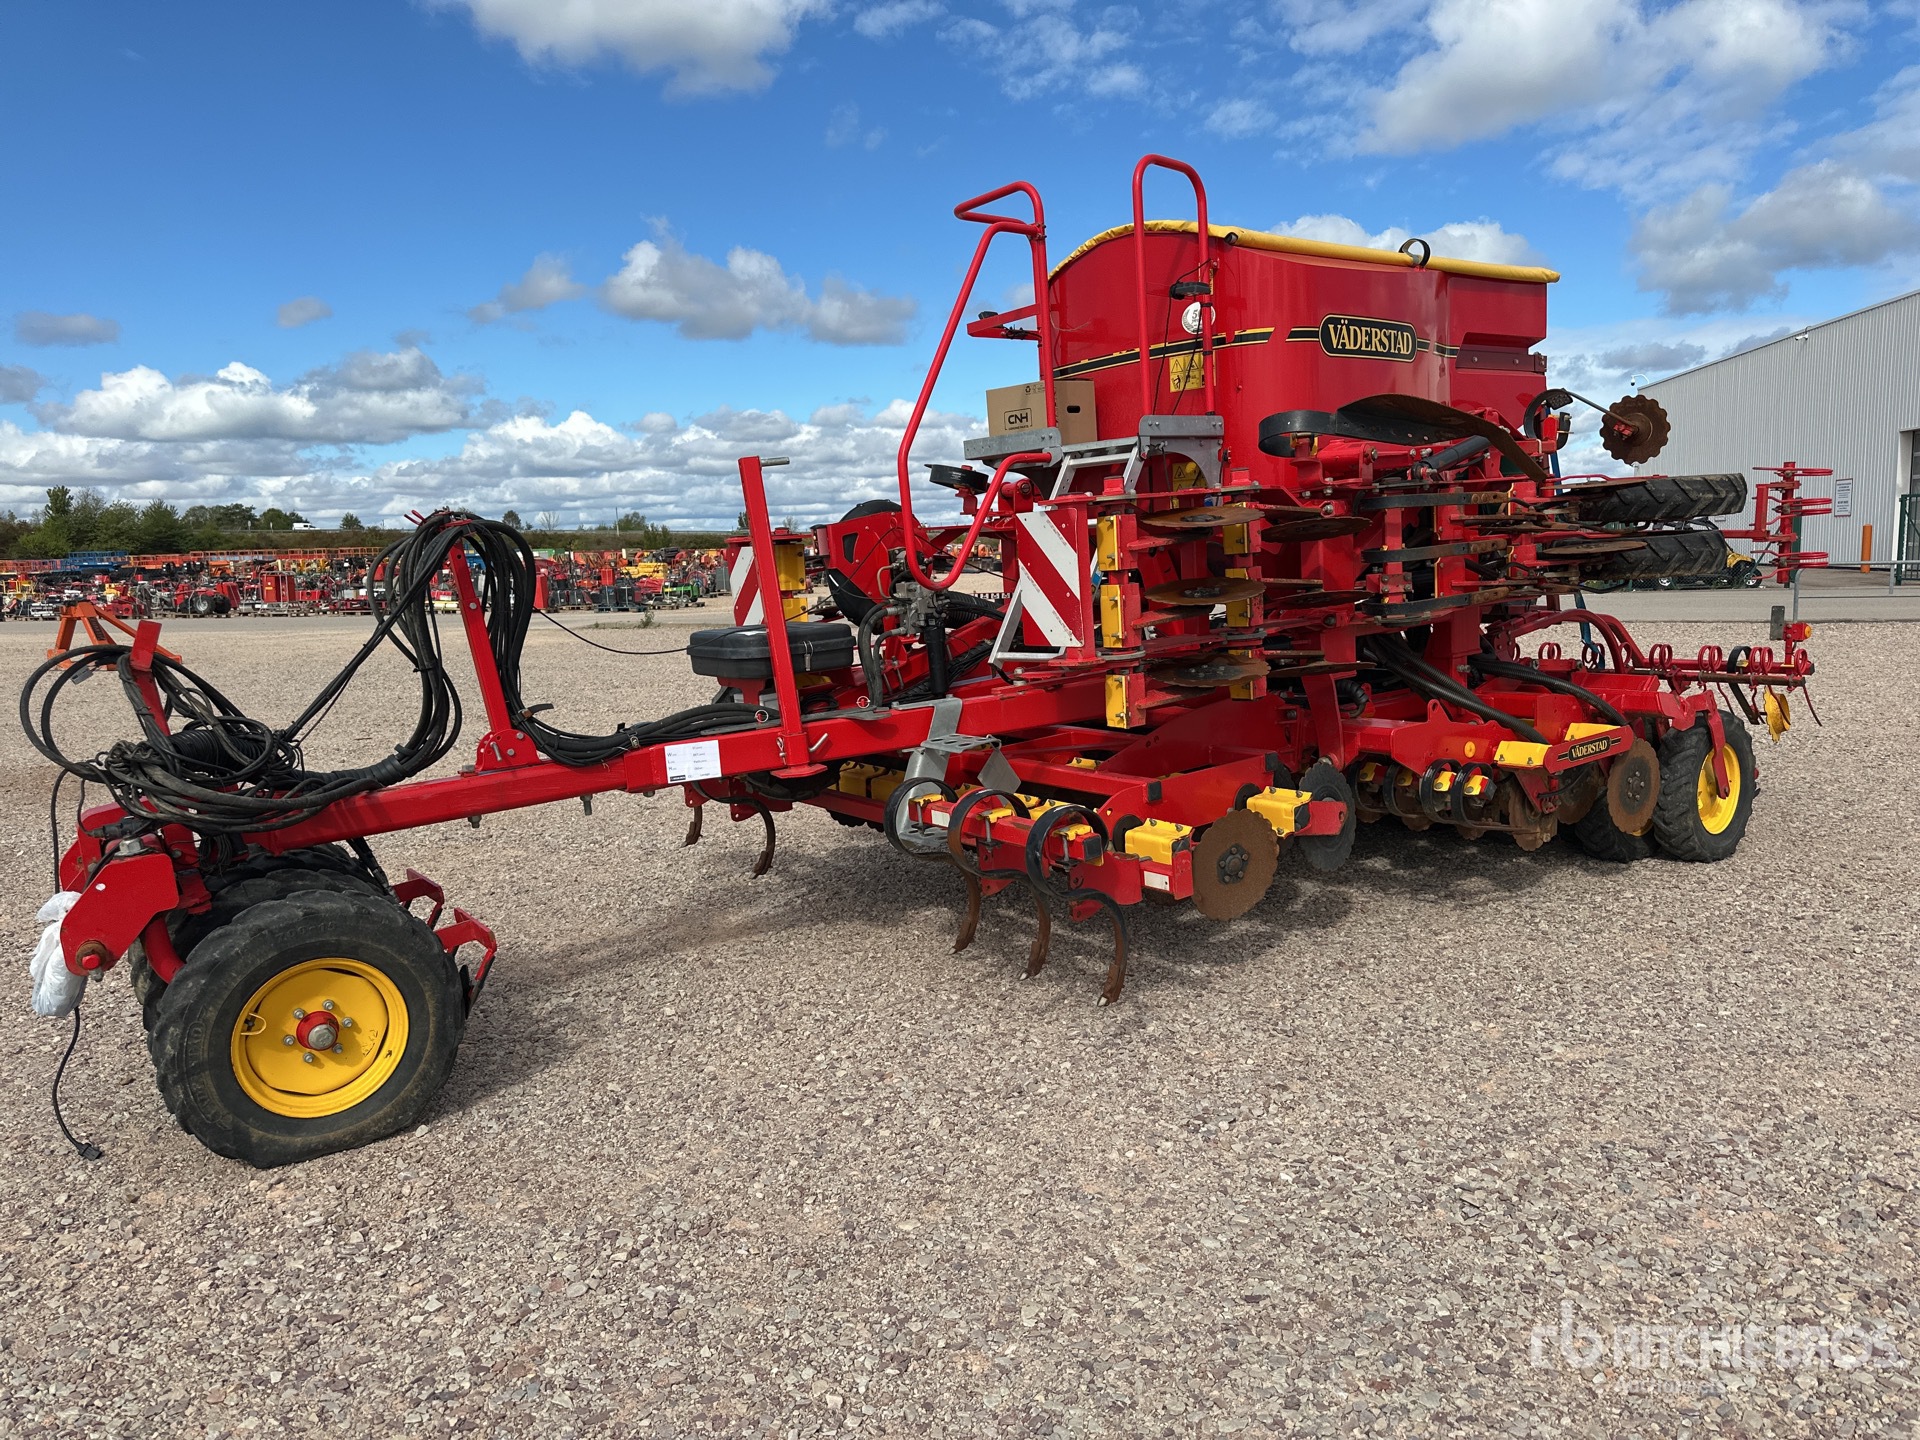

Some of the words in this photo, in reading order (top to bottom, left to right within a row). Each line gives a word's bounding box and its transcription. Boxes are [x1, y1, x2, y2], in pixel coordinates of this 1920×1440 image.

[1327, 319, 1412, 355] VÄDERSTAD
[1008, 412, 1028, 424] CNH
[1571, 740, 1608, 758] VÄDERSTAD
